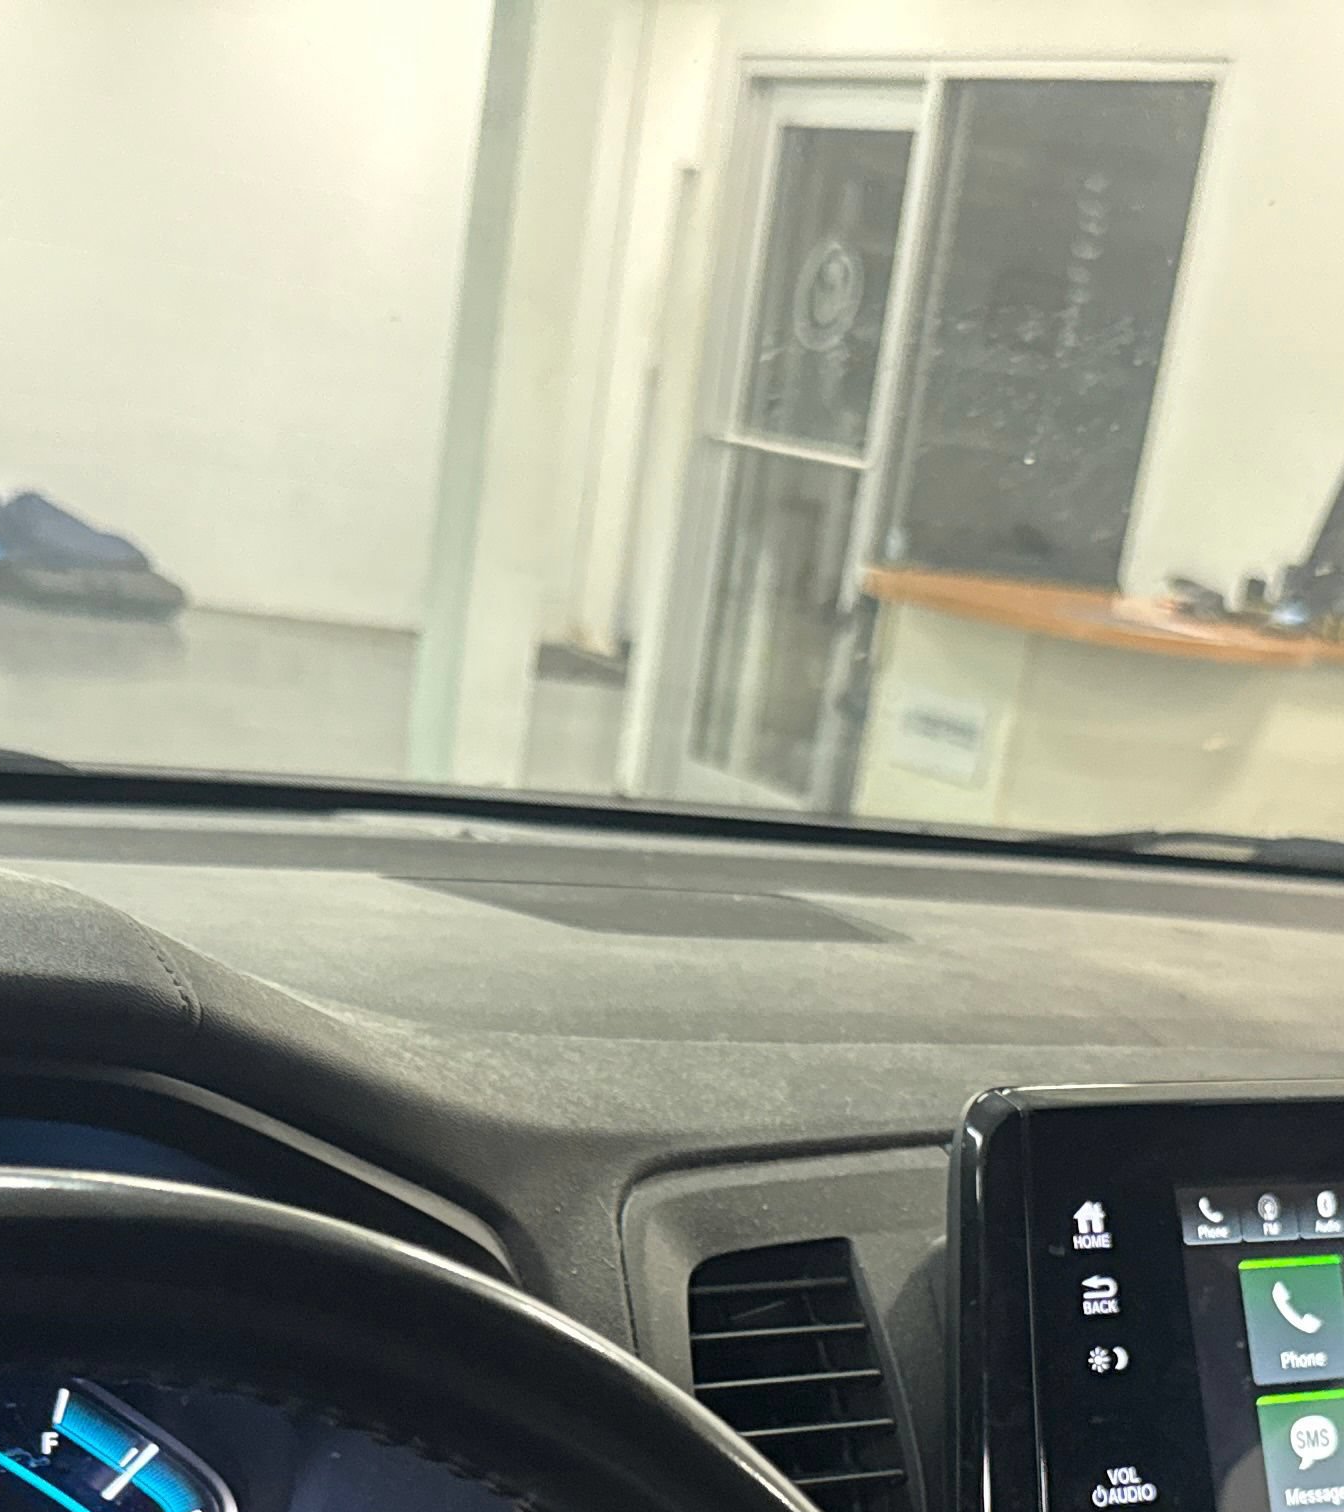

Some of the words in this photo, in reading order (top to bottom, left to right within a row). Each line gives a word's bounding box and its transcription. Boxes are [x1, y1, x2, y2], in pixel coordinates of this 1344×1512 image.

[1073, 1232, 1112, 1249] HOME
[1083, 1298, 1119, 1316] BACK
[1280, 1351, 1328, 1369] Phone
[41, 1431, 59, 1455] F
[1296, 1428, 1330, 1450] SMS
[1107, 1466, 1141, 1485] VOL
[1108, 1484, 1156, 1505] AUDIO
